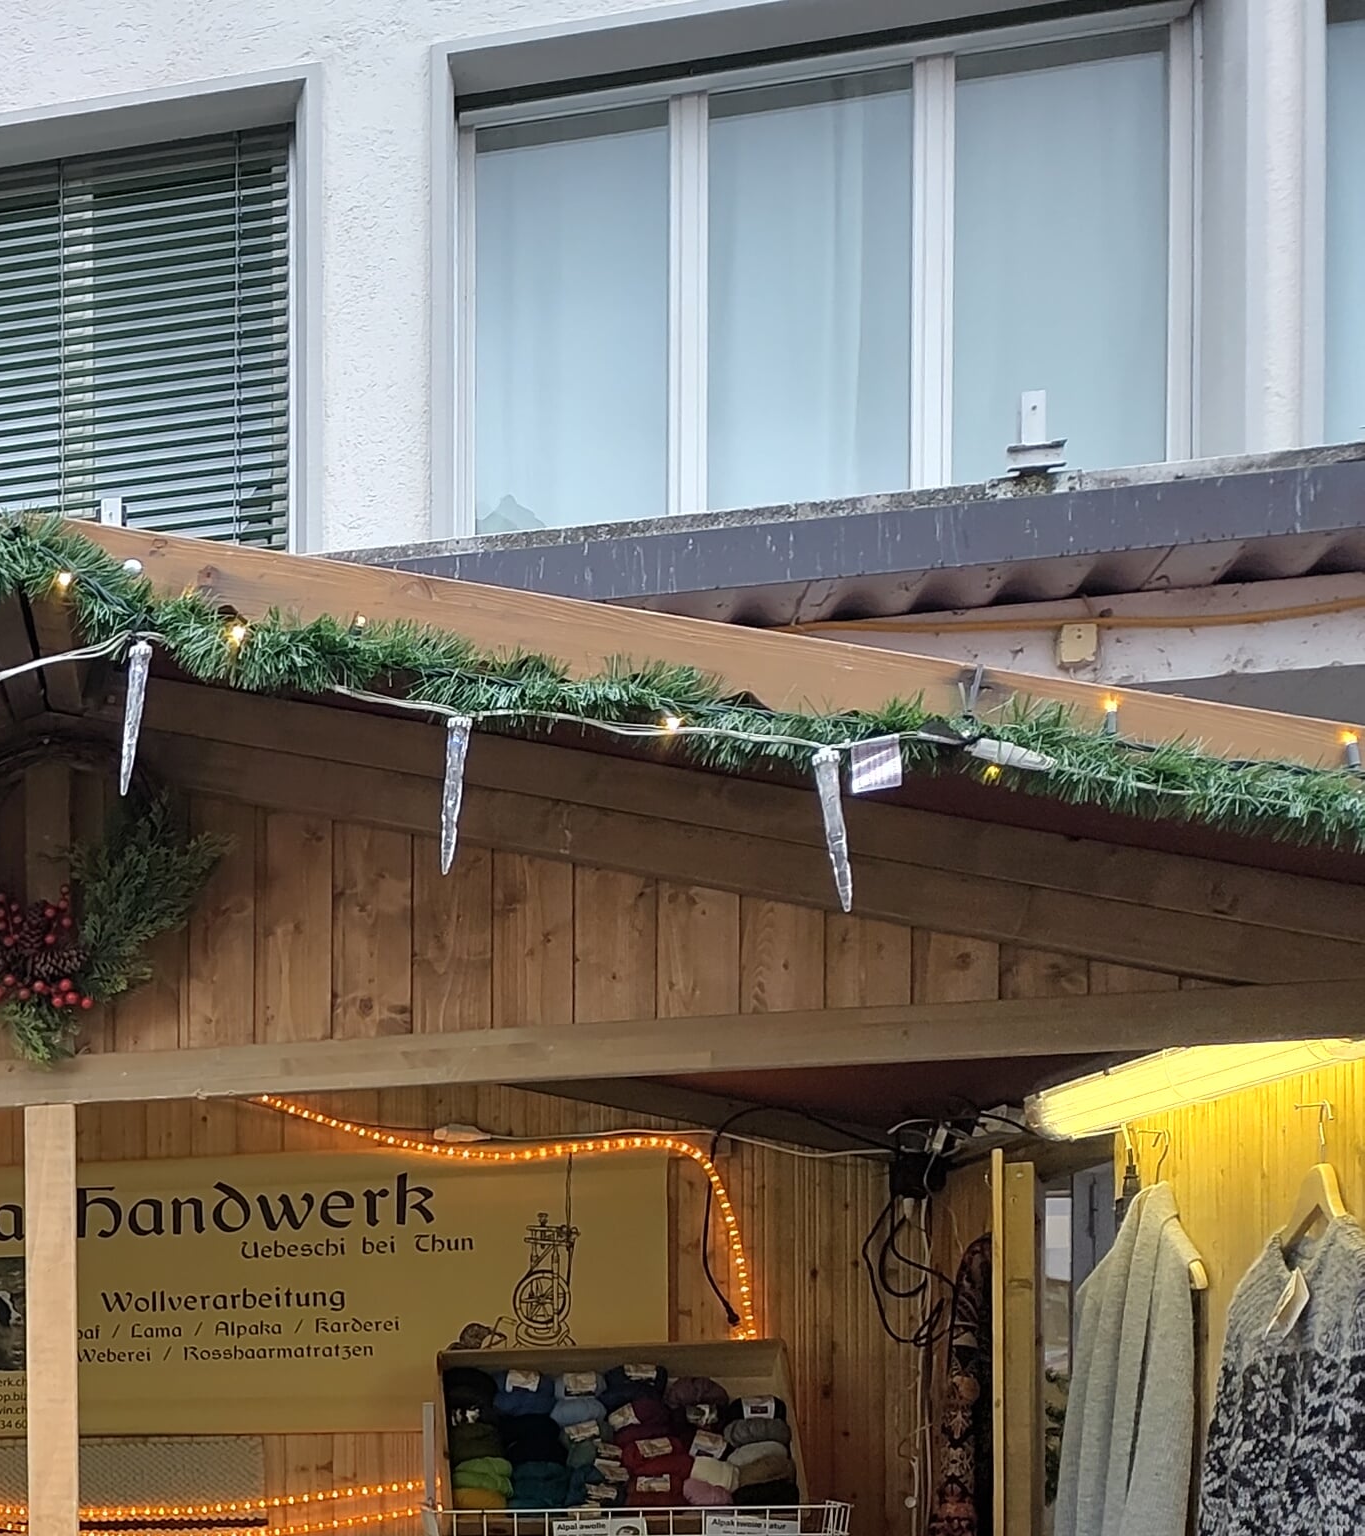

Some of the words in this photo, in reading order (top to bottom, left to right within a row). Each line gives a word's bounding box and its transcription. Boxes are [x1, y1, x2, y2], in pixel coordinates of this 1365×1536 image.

[240, 1238, 347, 1260] Uebeschi
[362, 1235, 397, 1255] bei
[414, 1232, 475, 1253] Thun
[100, 1286, 347, 1314] Wollverarbeitung
[131, 1323, 183, 1339] Lama
[214, 1319, 283, 1339] Alpaka
[314, 1315, 401, 1335] Karderei
[77, 1346, 152, 1363] Weberei
[183, 1342, 374, 1363] Rosshaarmatratzen
[0, 1420, 13, 1429] 34
[15, 1420, 28, 1430] 60
